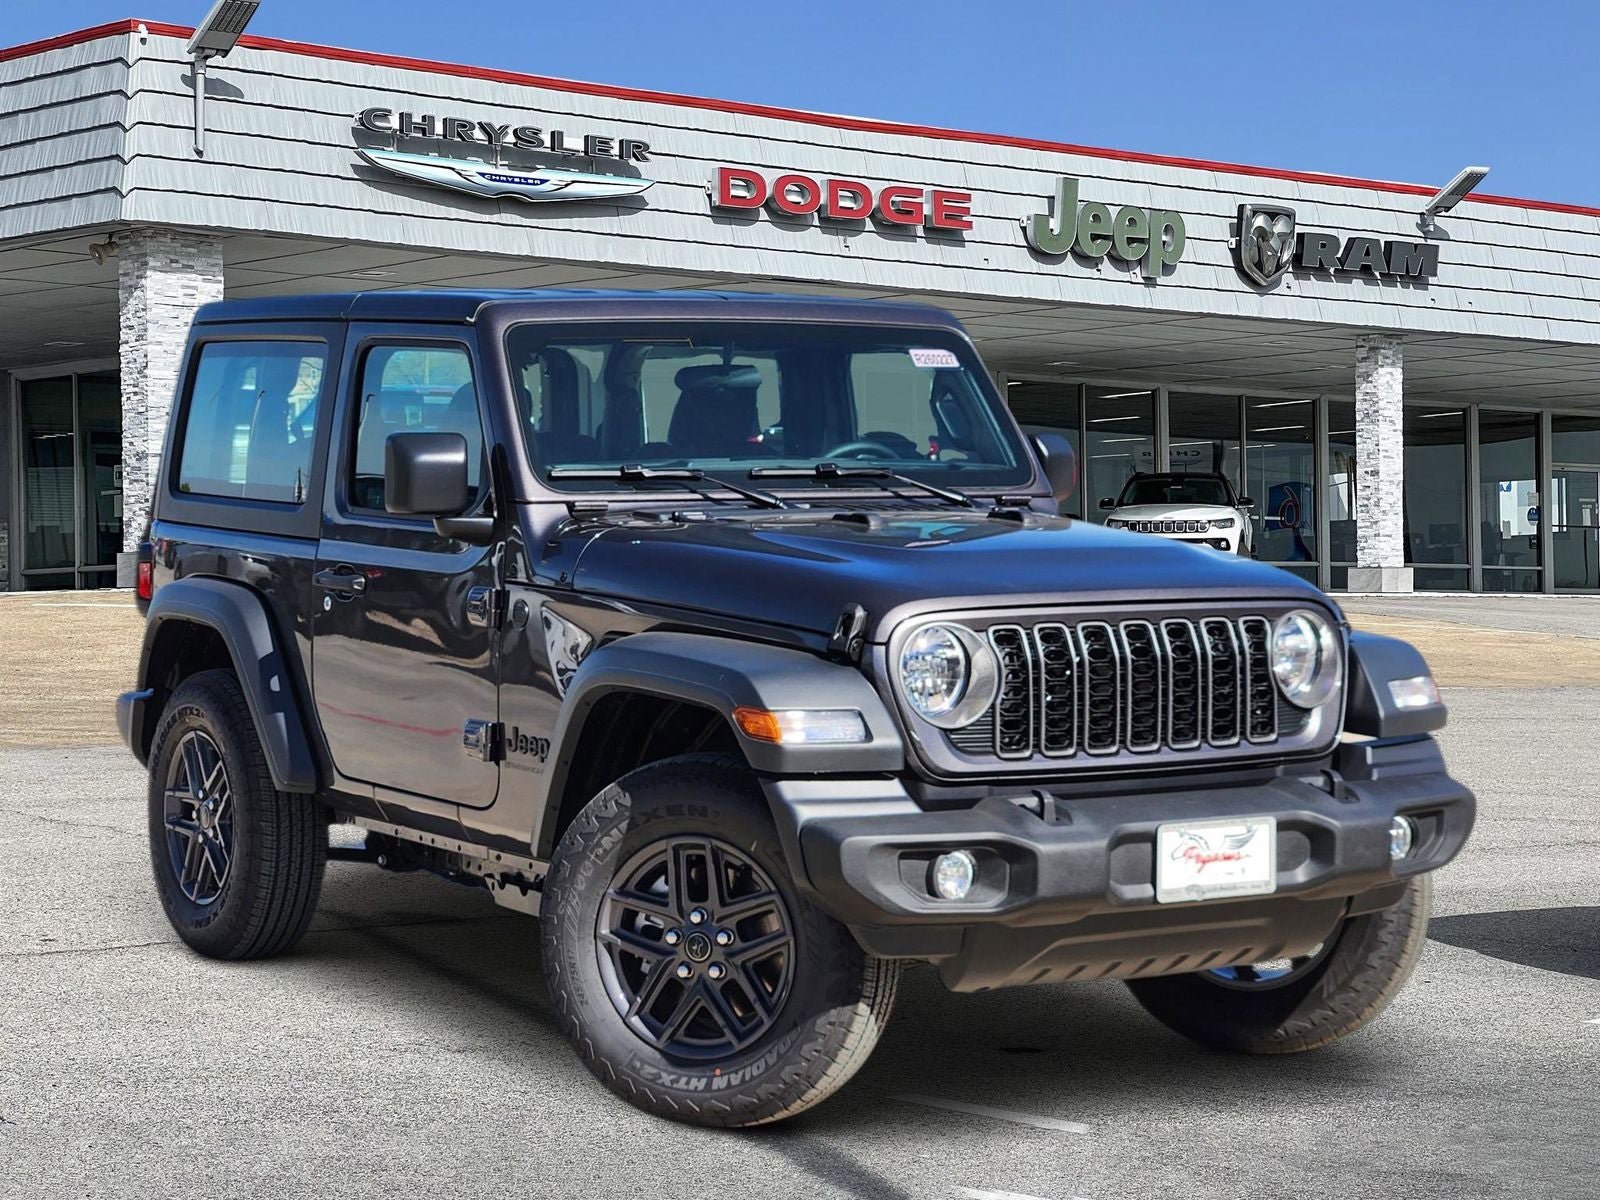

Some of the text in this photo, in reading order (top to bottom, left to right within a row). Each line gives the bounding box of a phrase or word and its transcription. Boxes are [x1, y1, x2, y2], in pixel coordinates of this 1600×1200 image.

[358, 106, 651, 162] CHRYSLER
[484, 174, 541, 185] CHRYSLER
[713, 166, 973, 230] DODGE
[1027, 177, 1186, 278] Jeep
[1300, 232, 1439, 278] RAM
[506, 726, 551, 763] Jeep
